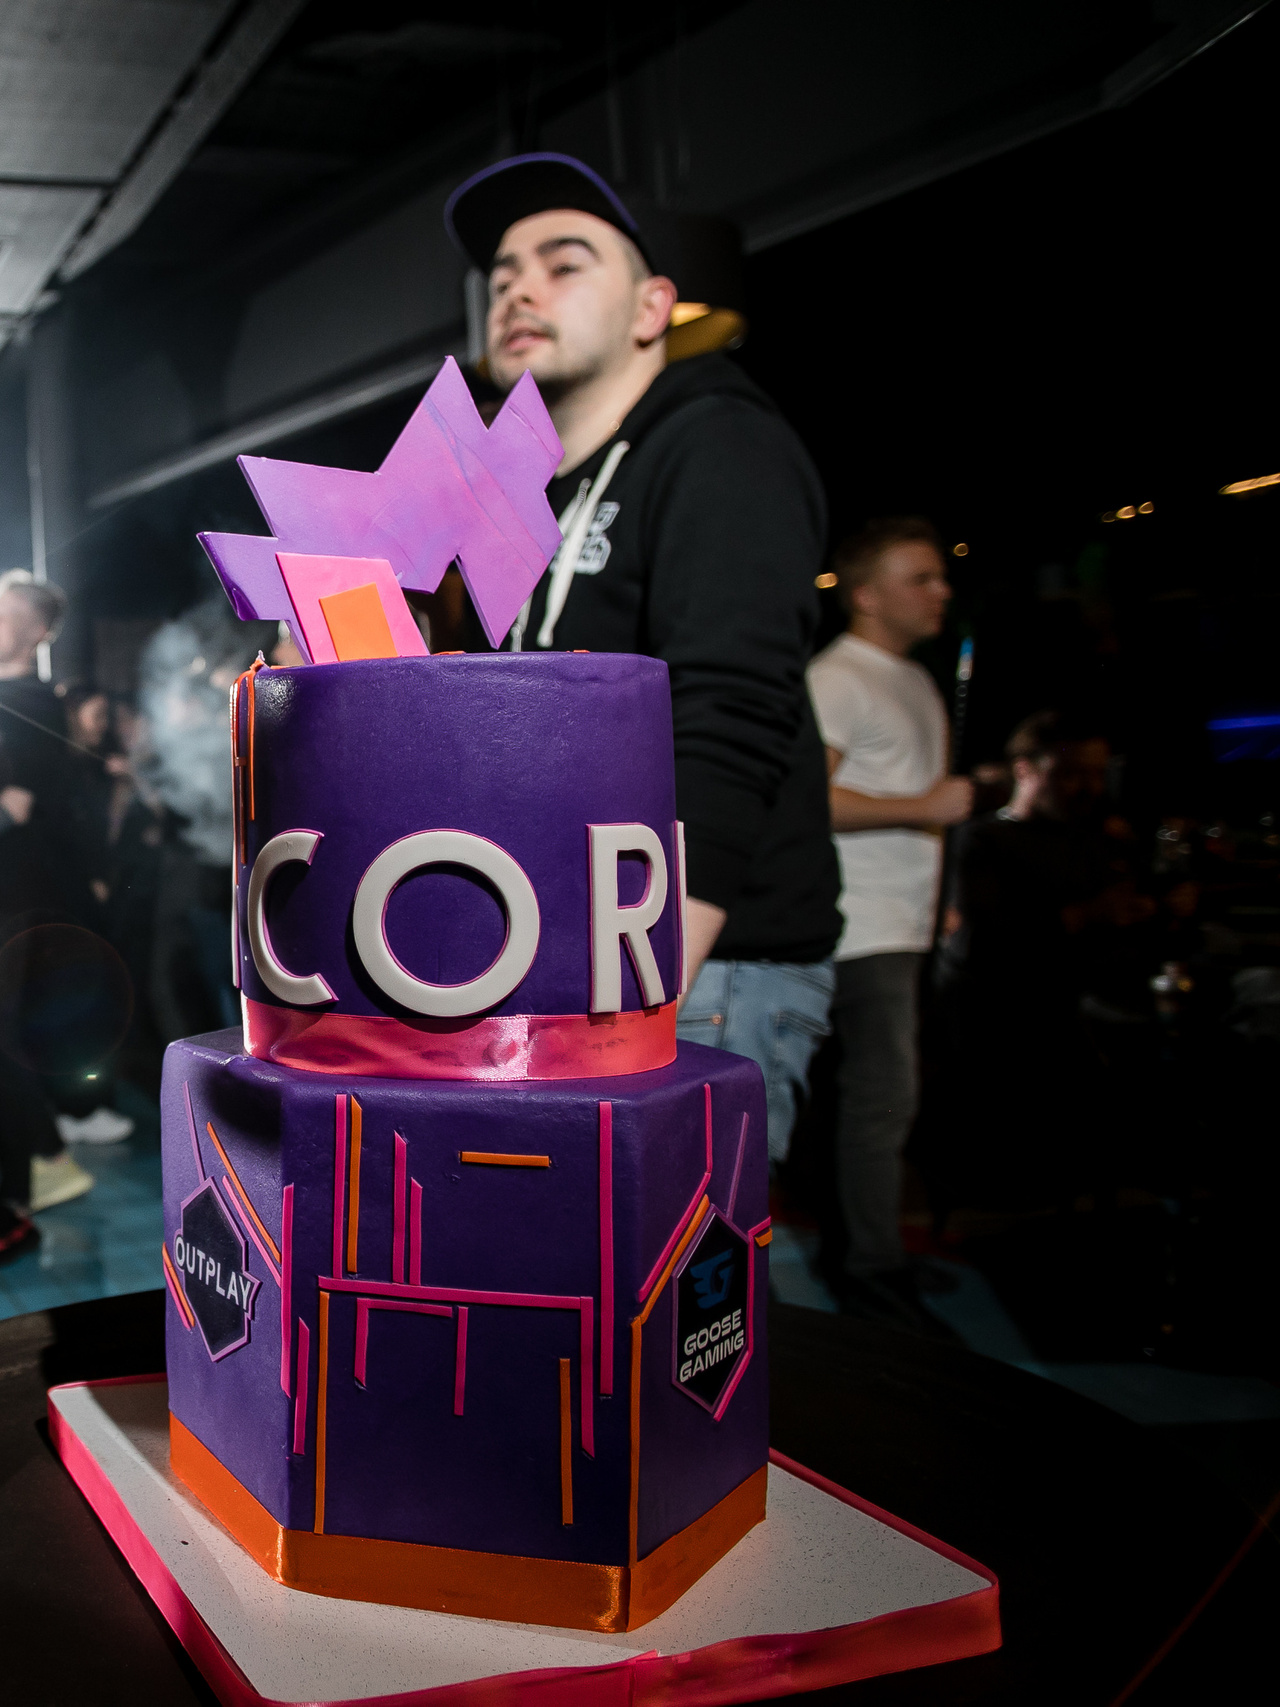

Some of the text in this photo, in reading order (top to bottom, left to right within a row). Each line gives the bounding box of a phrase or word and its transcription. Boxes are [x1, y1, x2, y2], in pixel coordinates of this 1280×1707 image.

[232, 820, 688, 1016] COR
[175, 1236, 252, 1311] OUTPLAY
[679, 1329, 745, 1383] GAMING
[683, 1308, 742, 1356] GOOSE
